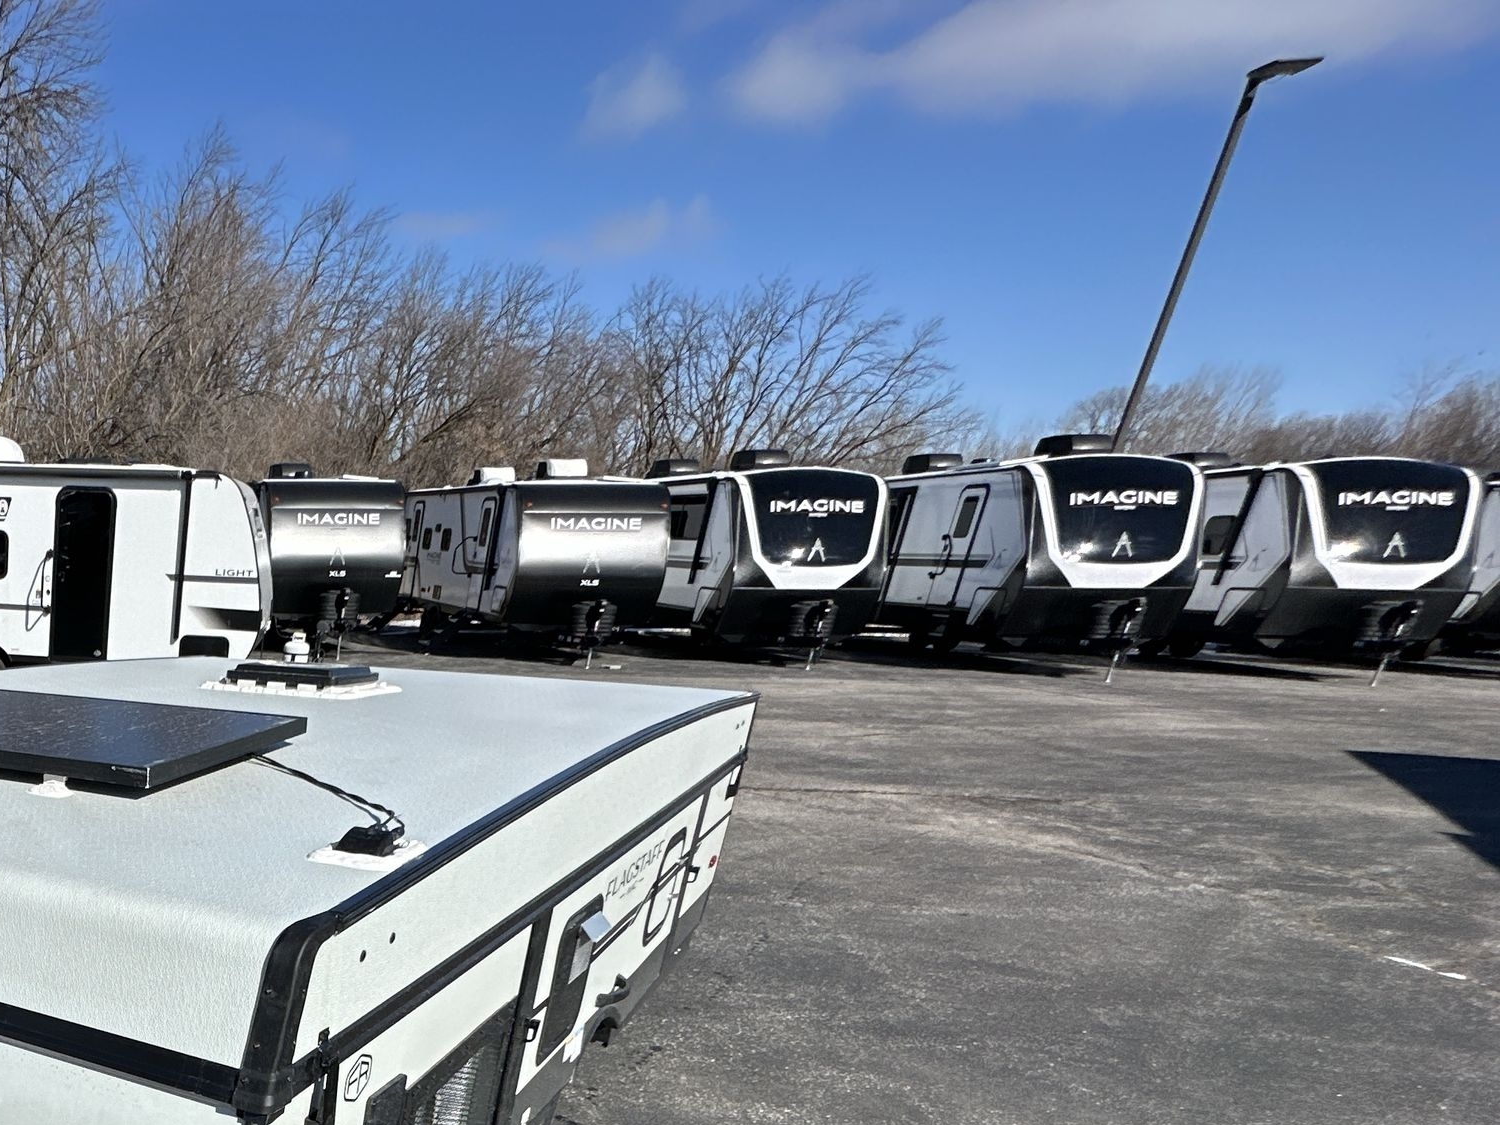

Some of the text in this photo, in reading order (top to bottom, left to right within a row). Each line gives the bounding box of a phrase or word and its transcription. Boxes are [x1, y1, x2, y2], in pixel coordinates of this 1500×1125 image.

[1069, 489, 1178, 506] IMAGINE
[1338, 489, 1454, 506] IMAGINE
[769, 499, 864, 513] IMAGINE
[297, 512, 381, 525] IMAGINE
[550, 517, 642, 530] IMAGINE
[215, 569, 254, 577] LIGHT
[605, 840, 666, 901] FLAGSTAFF
